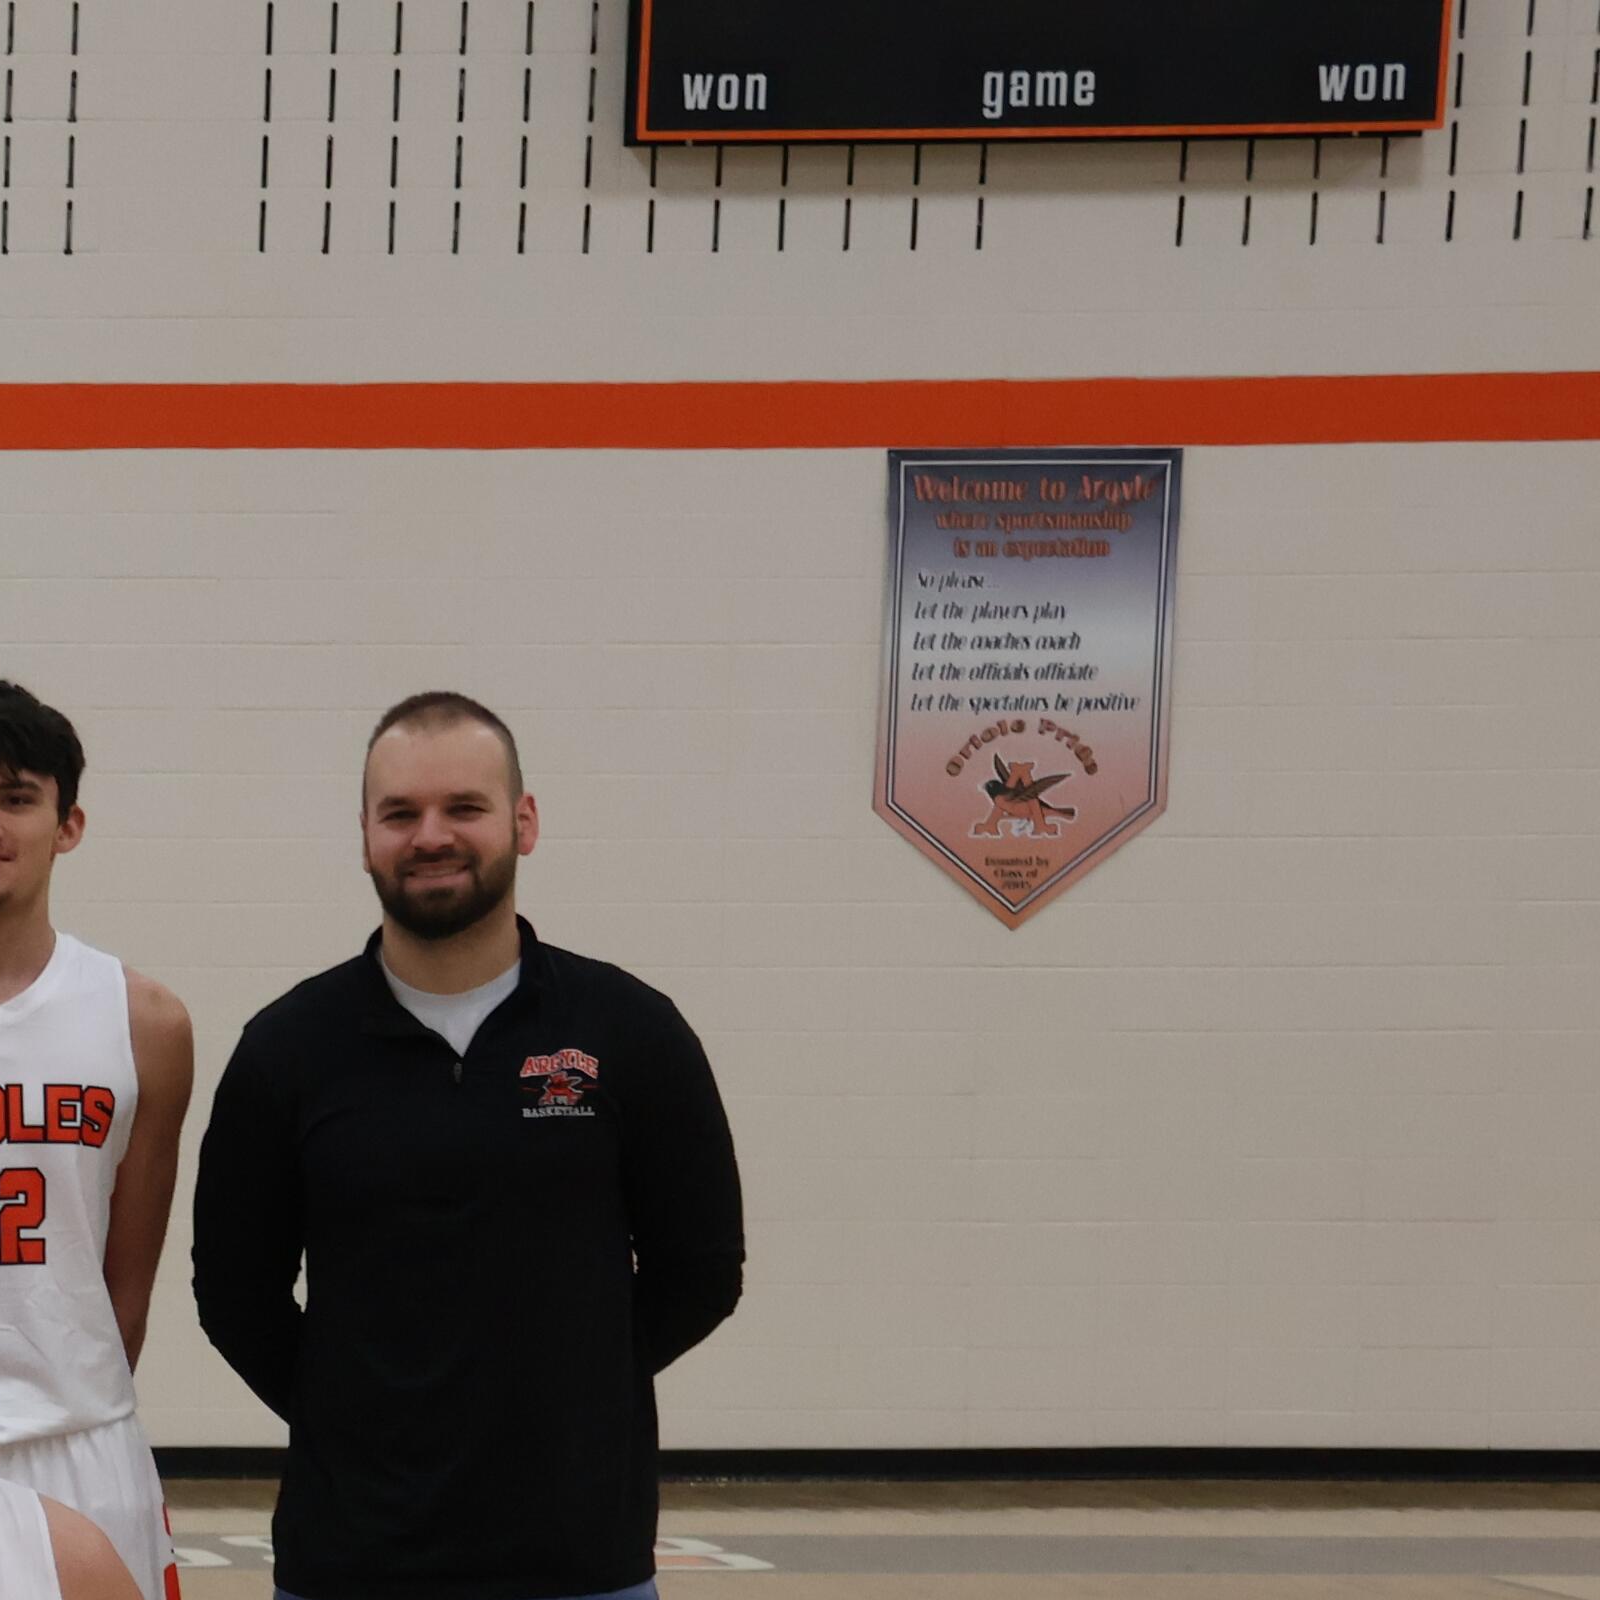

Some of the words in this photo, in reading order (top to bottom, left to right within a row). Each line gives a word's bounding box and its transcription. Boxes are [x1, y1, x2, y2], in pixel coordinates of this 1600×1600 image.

[682, 71, 768, 112] won
[982, 68, 1097, 119] game
[1318, 63, 1406, 103] won
[913, 474, 1029, 501] Welcome
[1040, 475, 1067, 501] to
[1080, 473, 1159, 505] Argyle
[936, 511, 988, 530] where
[995, 510, 1133, 533] sportsmanship
[954, 537, 970, 558] is
[975, 540, 998, 558] an
[1002, 537, 1111, 561] expectation
[914, 601, 937, 619] Let
[942, 601, 963, 619] the
[971, 601, 1029, 623] players
[1033, 601, 1066, 623] play
[913, 632, 936, 650] Let
[941, 632, 967, 650] the
[970, 632, 1031, 650] coaches
[1034, 631, 1081, 650] coach
[912, 662, 936, 680] Let
[939, 662, 966, 680] the
[968, 662, 1029, 681] officials
[1034, 662, 1098, 681] officiate
[910, 693, 936, 711] Let
[938, 693, 963, 711] the
[969, 693, 1048, 715] spectators
[1054, 693, 1073, 711] be
[1076, 691, 1140, 715] positive
[946, 718, 1026, 777] Oriole
[1037, 718, 1098, 776] Pride
[519, 1048, 599, 1079] ARGYLE
